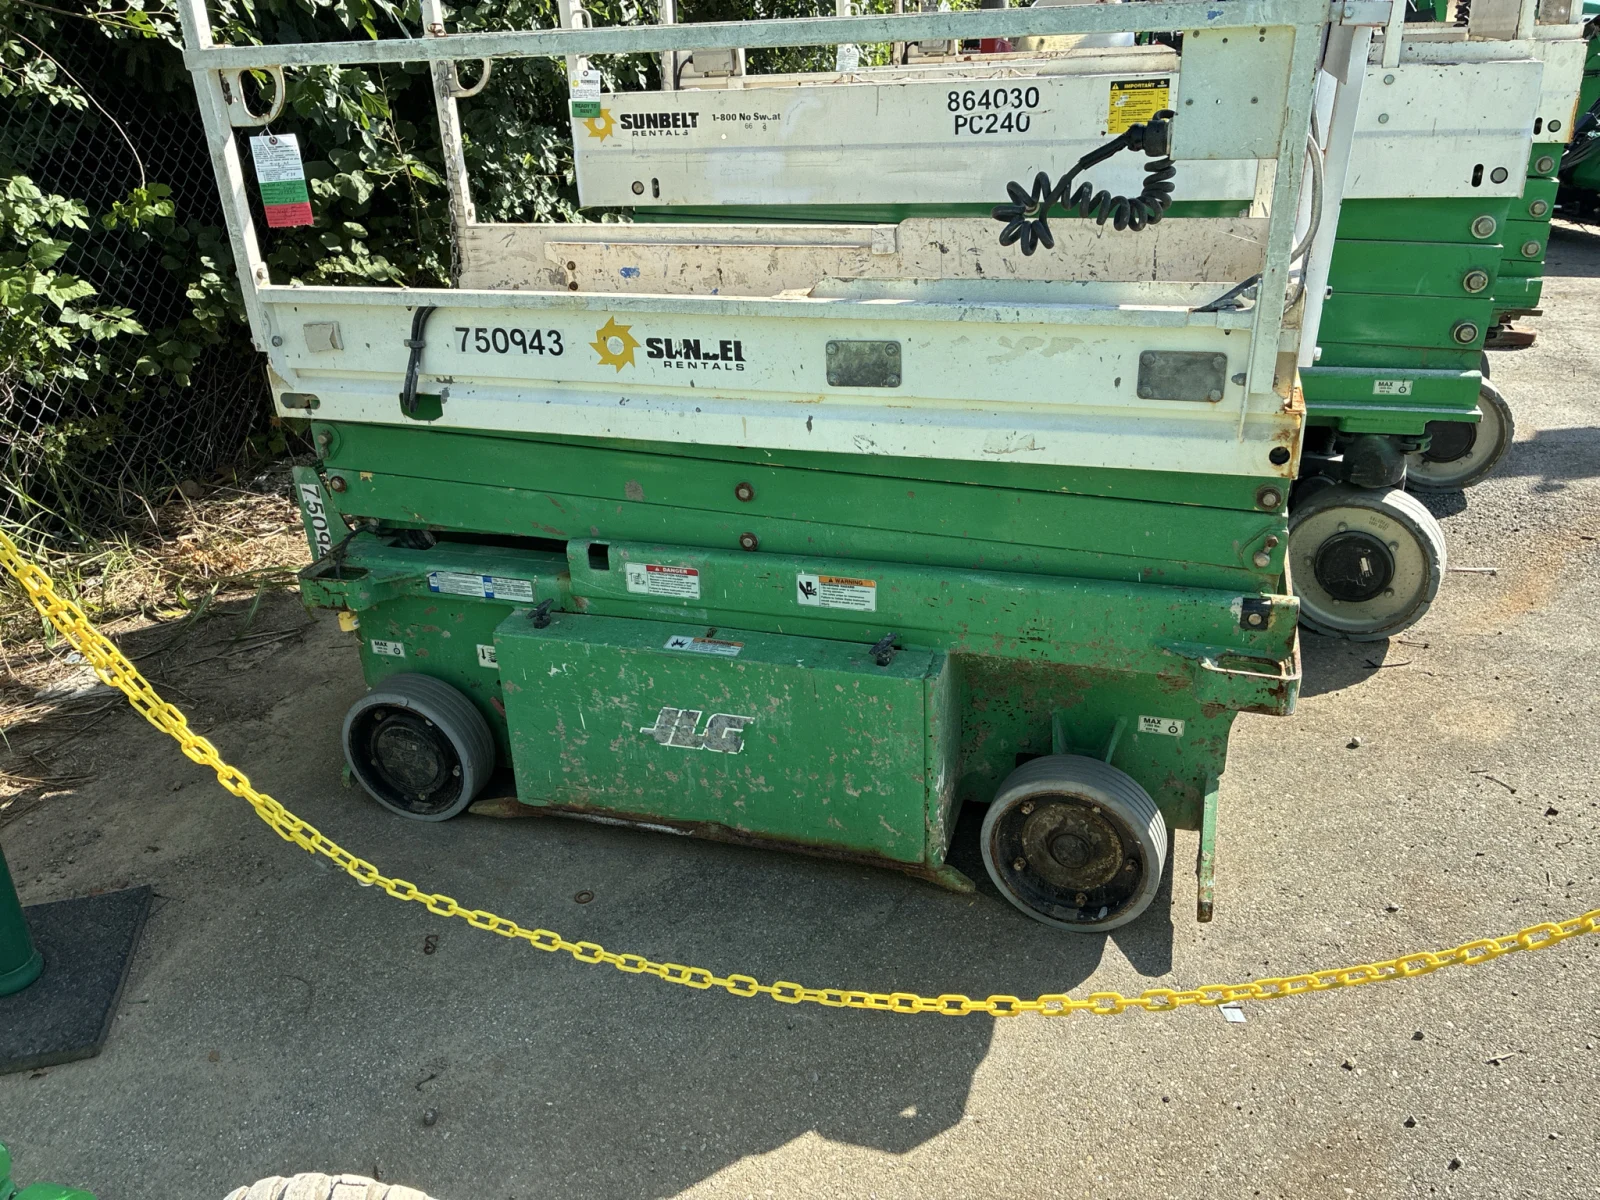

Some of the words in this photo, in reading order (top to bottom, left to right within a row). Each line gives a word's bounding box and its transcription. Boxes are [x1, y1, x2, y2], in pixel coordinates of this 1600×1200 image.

[947, 86, 1040, 112] 864030
[619, 112, 699, 129] SUNBELT
[711, 113, 737, 121] 1-800
[739, 113, 752, 121] No
[954, 111, 1031, 135] PC240
[455, 327, 564, 356] 750943
[663, 360, 745, 372] RENTALS
[662, 567, 688, 575] DANGER
[834, 577, 864, 586] WARNING
[1143, 717, 1162, 725] MAX
